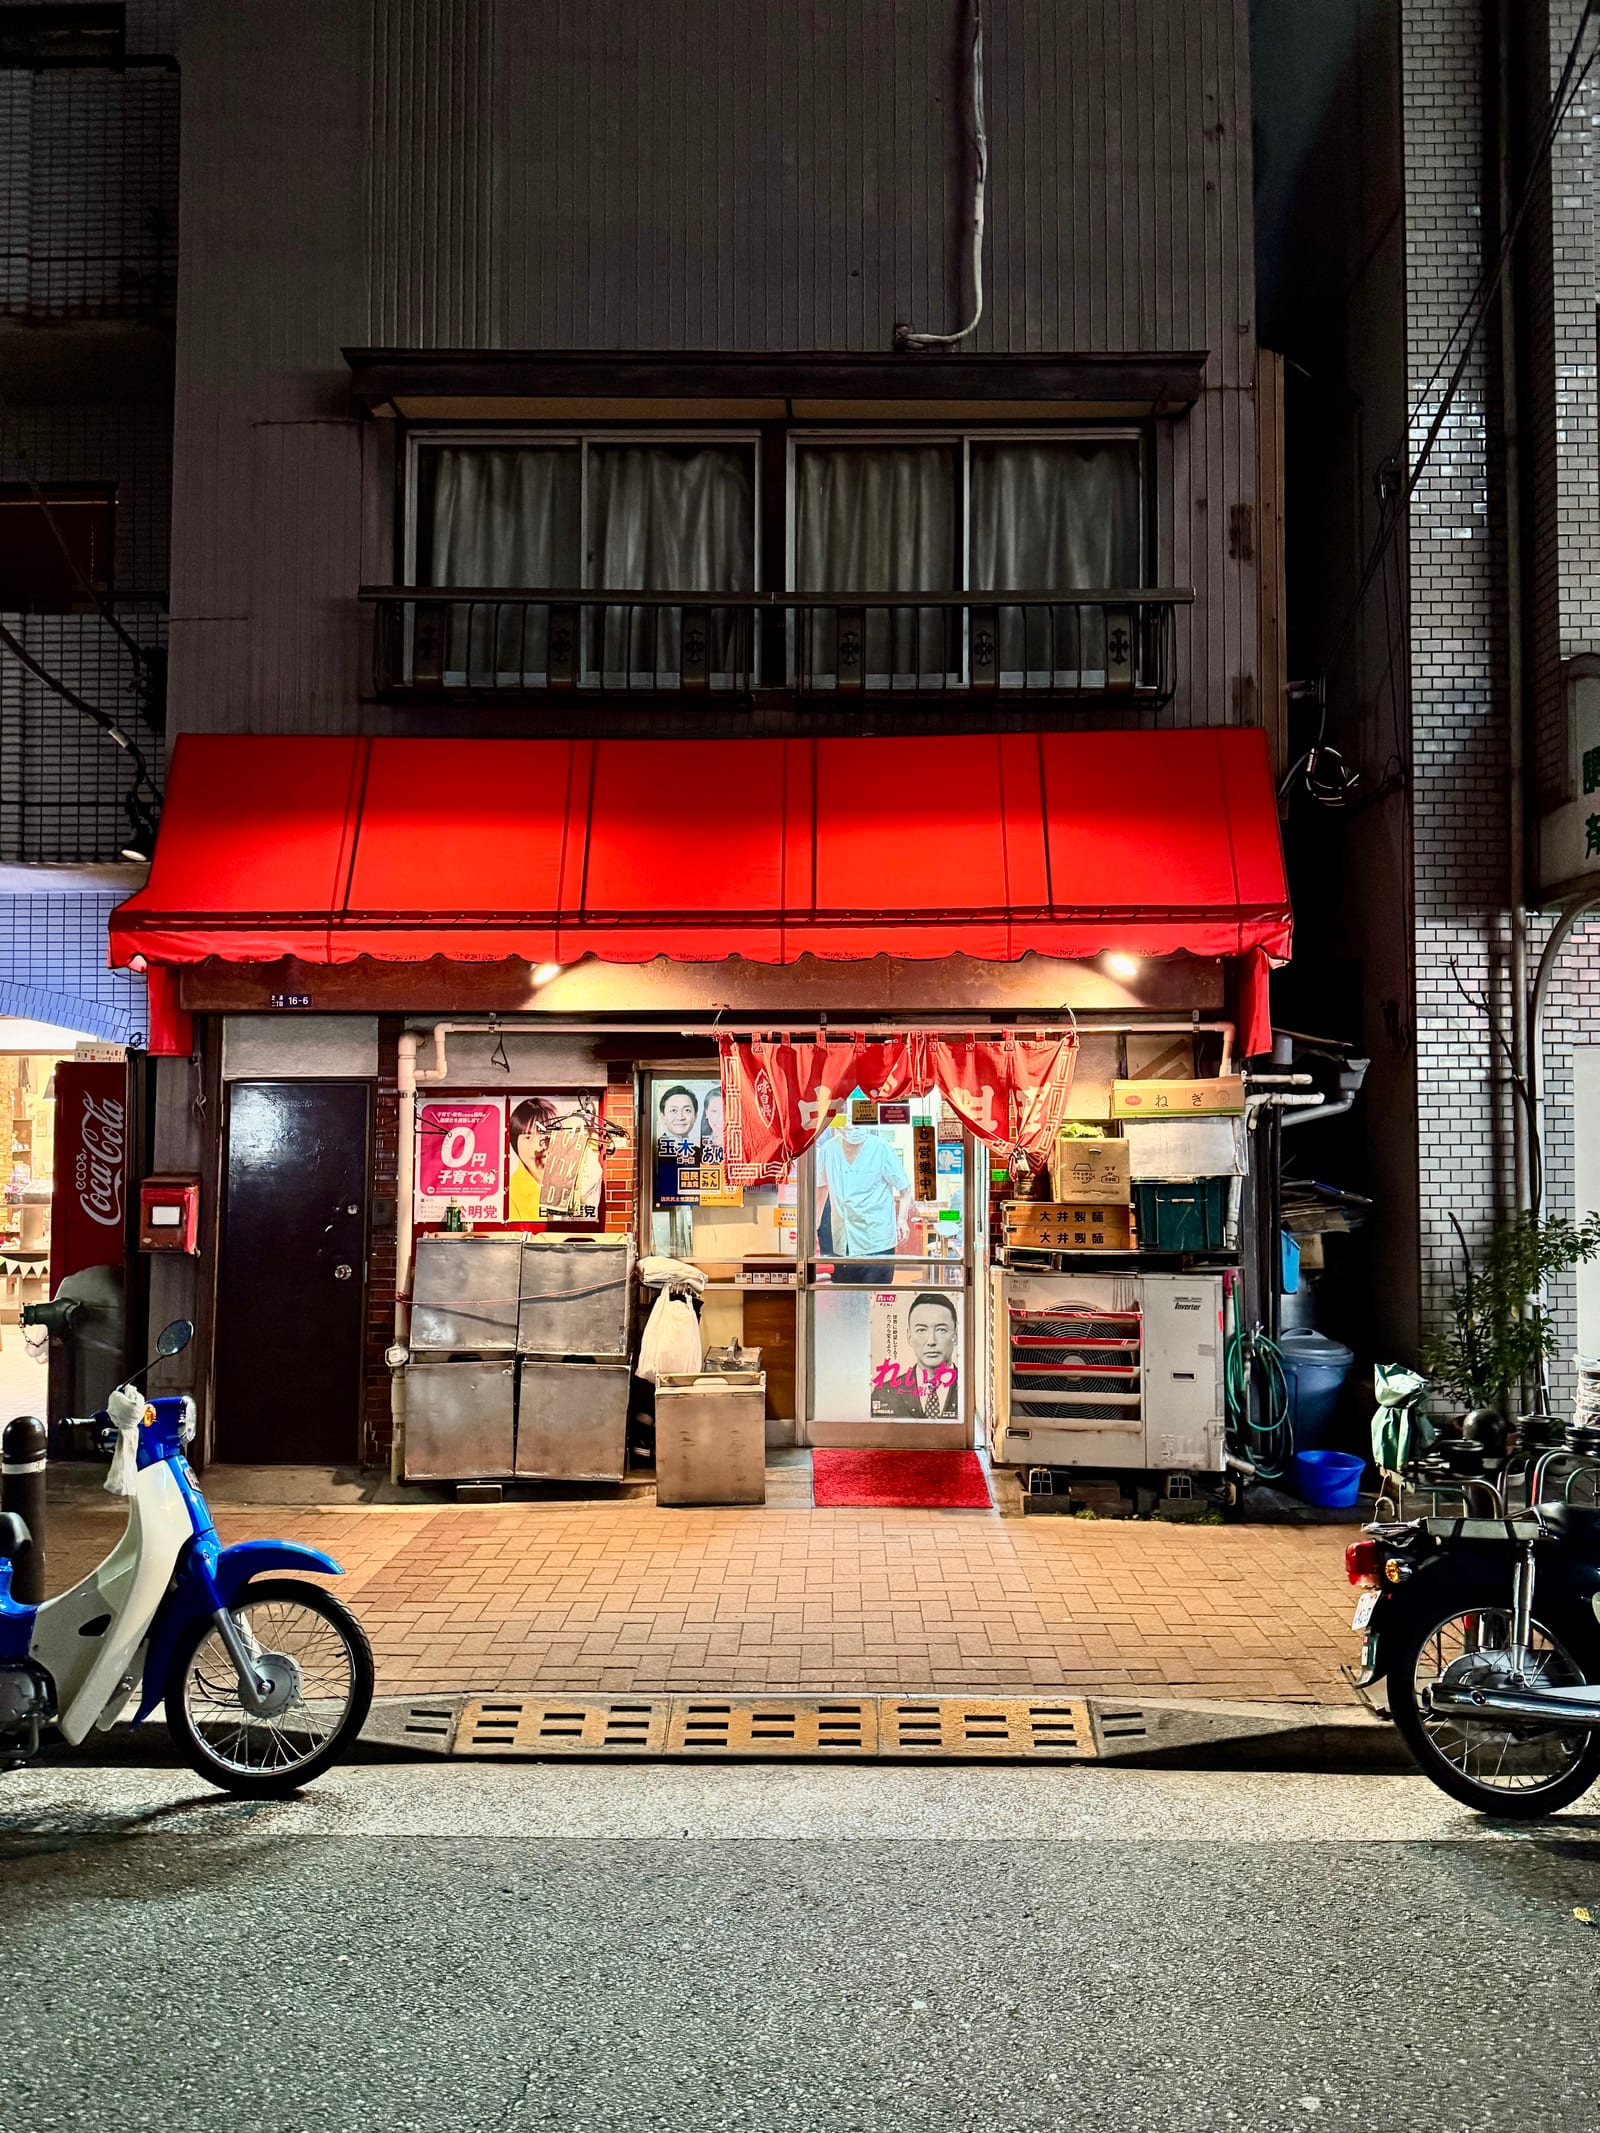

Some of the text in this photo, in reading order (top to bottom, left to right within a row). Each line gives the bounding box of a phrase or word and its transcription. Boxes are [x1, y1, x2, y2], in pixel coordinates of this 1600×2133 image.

[288, 996, 309, 1006] 16-6
[1155, 1092, 1204, 1108] ねぎ
[659, 1138, 695, 1157] 玉木
[80, 1089, 124, 1226] Coca-Cola
[918, 1145, 932, 1189] 営業中
[438, 1169, 482, 1185] 子育て
[1174, 1302, 1201, 1312] Inverter
[872, 1357, 958, 1390] れいわ
